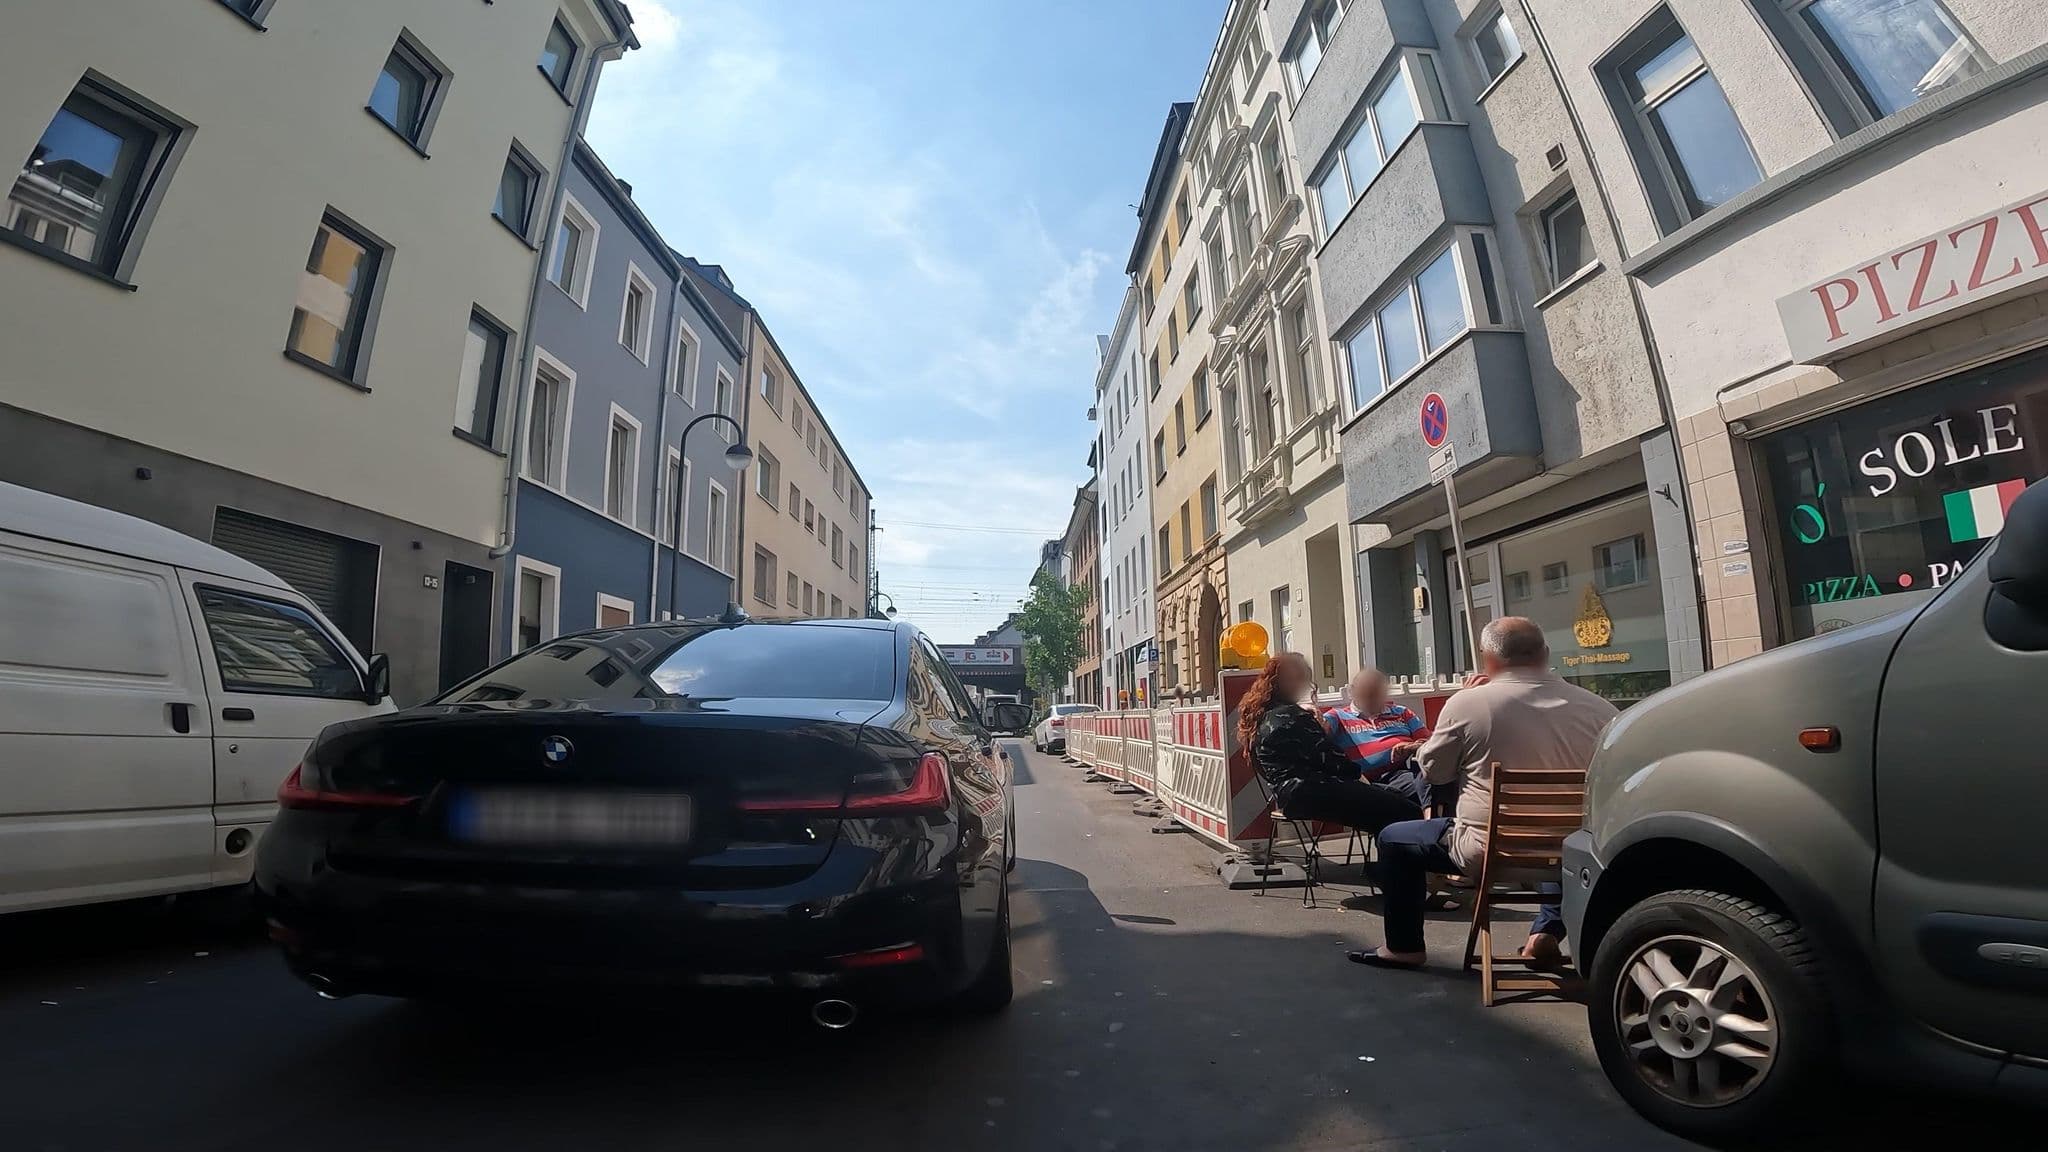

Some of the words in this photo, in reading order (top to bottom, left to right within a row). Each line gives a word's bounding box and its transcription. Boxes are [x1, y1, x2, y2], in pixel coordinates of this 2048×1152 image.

[1859, 403, 2025, 498] SOLE
[1801, 574, 1882, 603] PIZZA
[1562, 656, 1580, 667] Tiger
[1580, 653, 1630, 664] Thai-Massage
